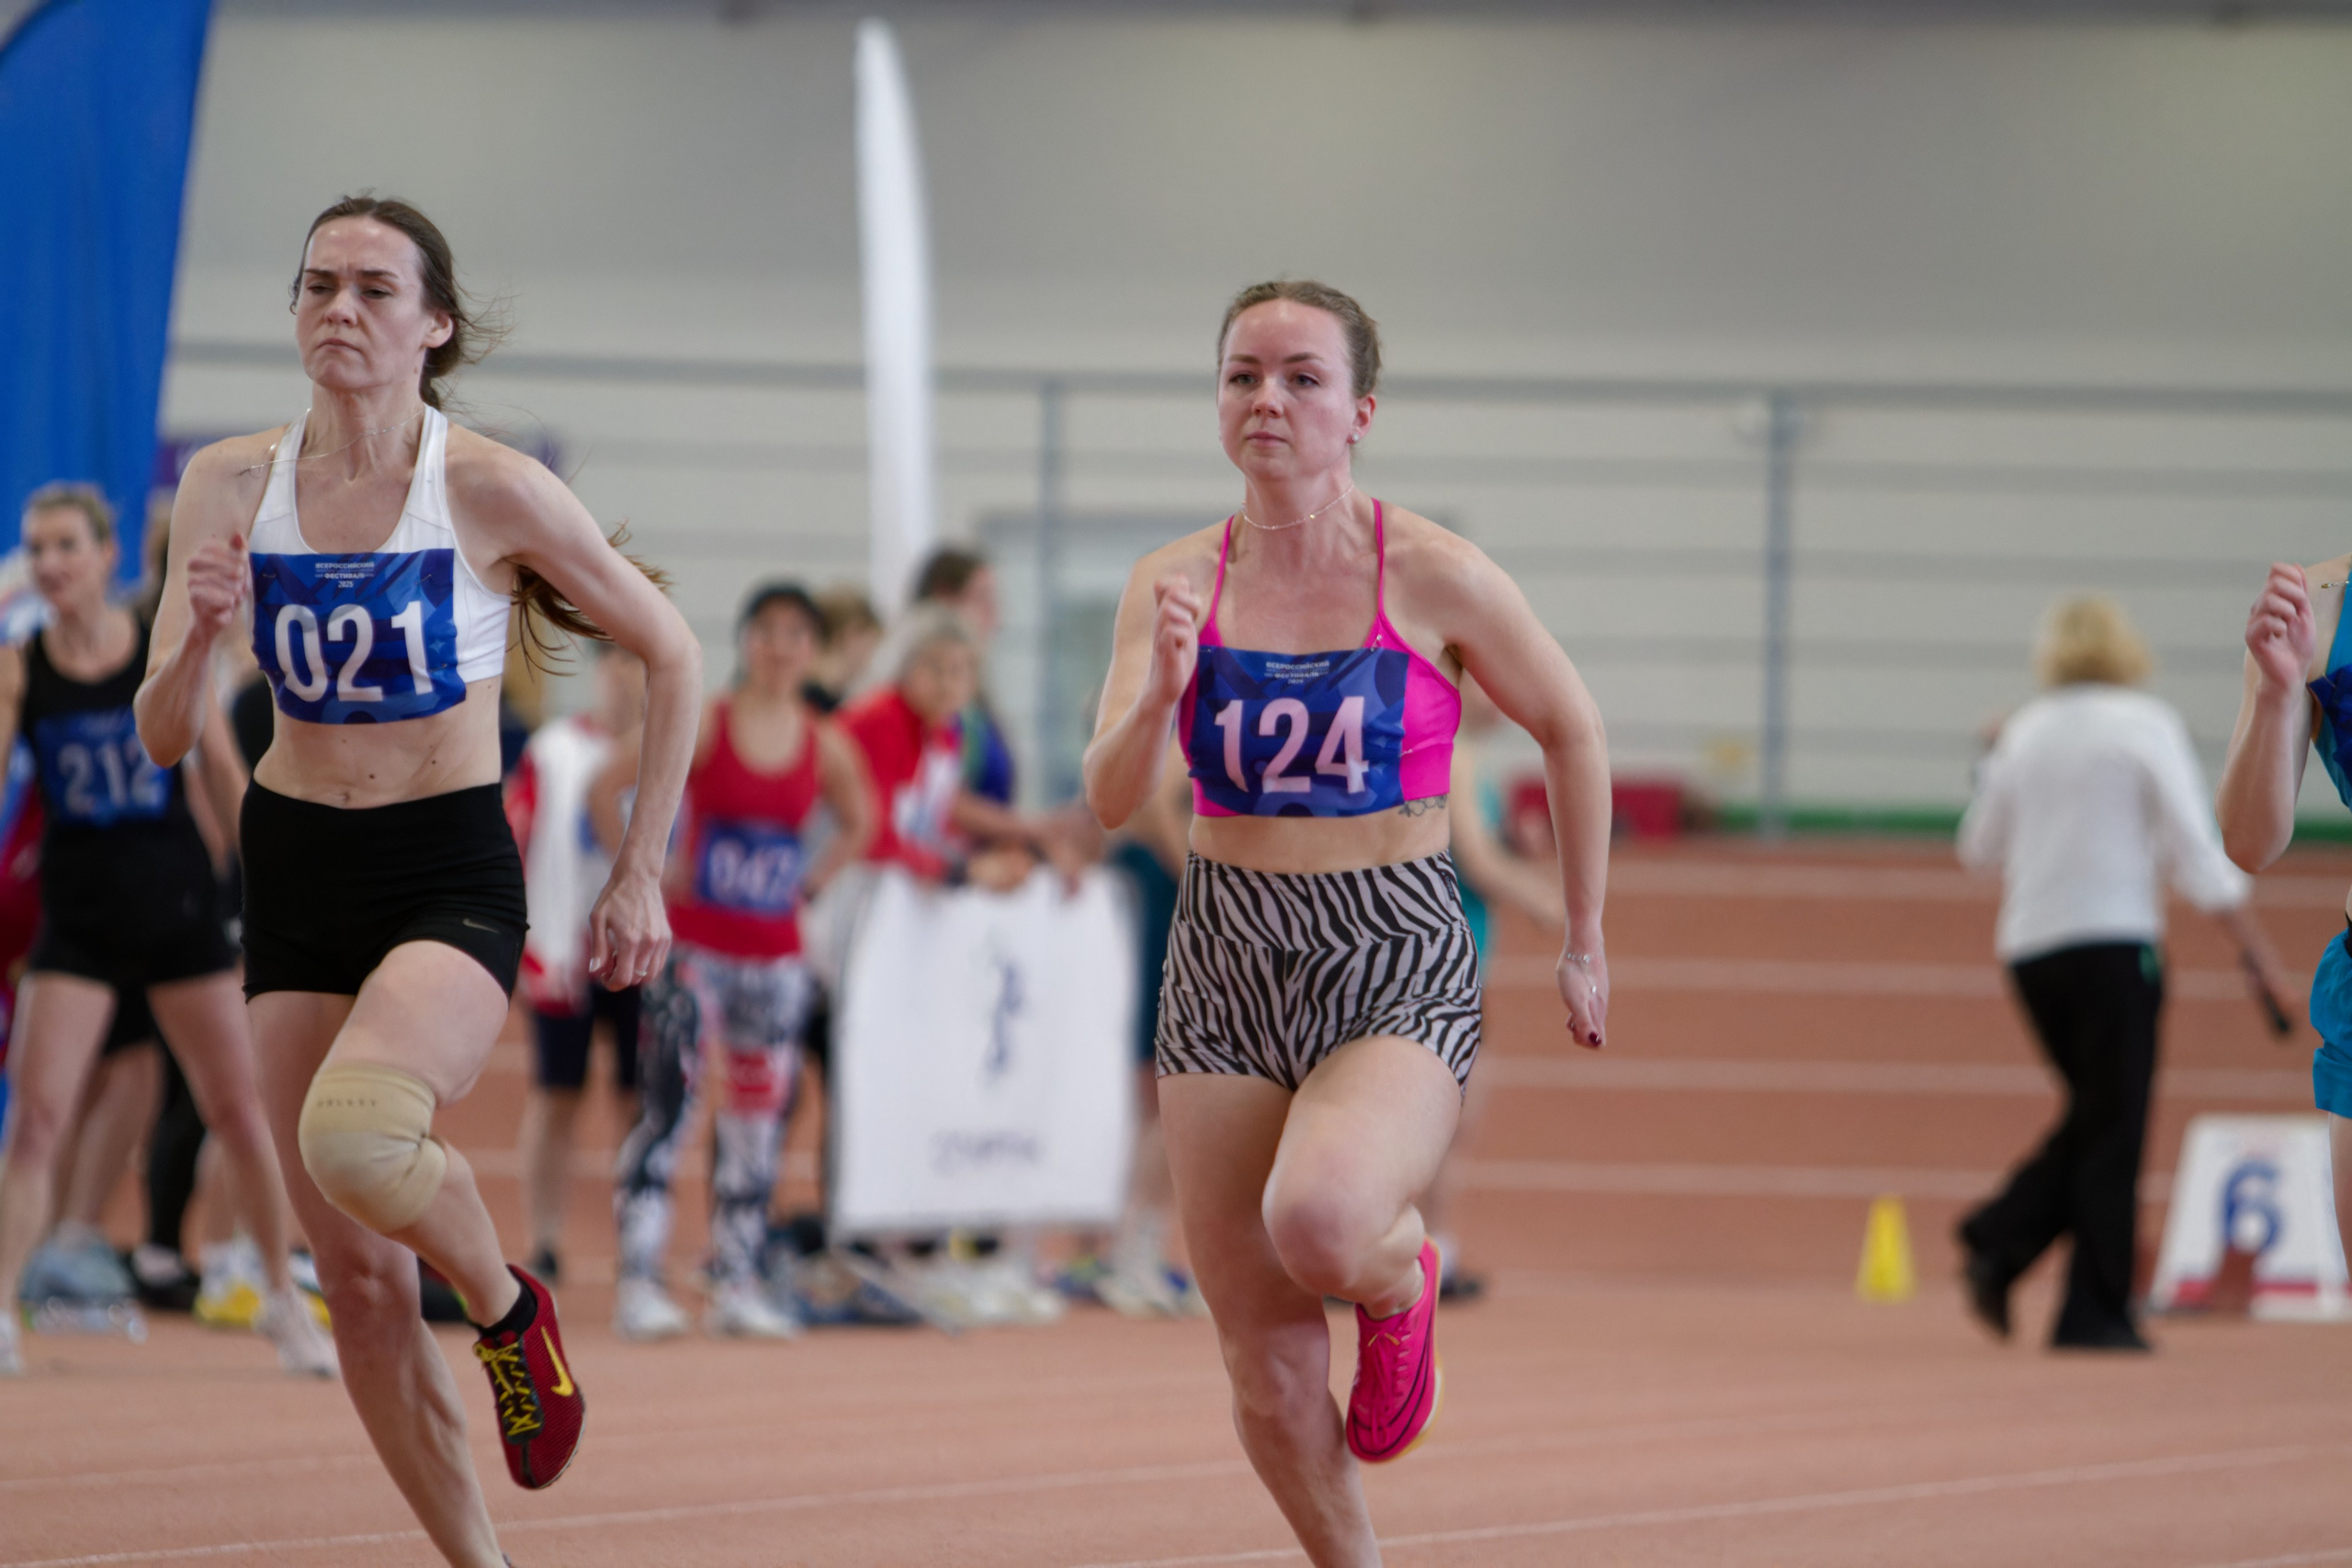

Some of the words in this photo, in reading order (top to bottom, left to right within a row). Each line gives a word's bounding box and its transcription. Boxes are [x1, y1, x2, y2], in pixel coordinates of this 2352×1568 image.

[275, 600, 434, 702] 021
[1214, 695, 1370, 794] 124
[2220, 1159, 2285, 1258] 6
